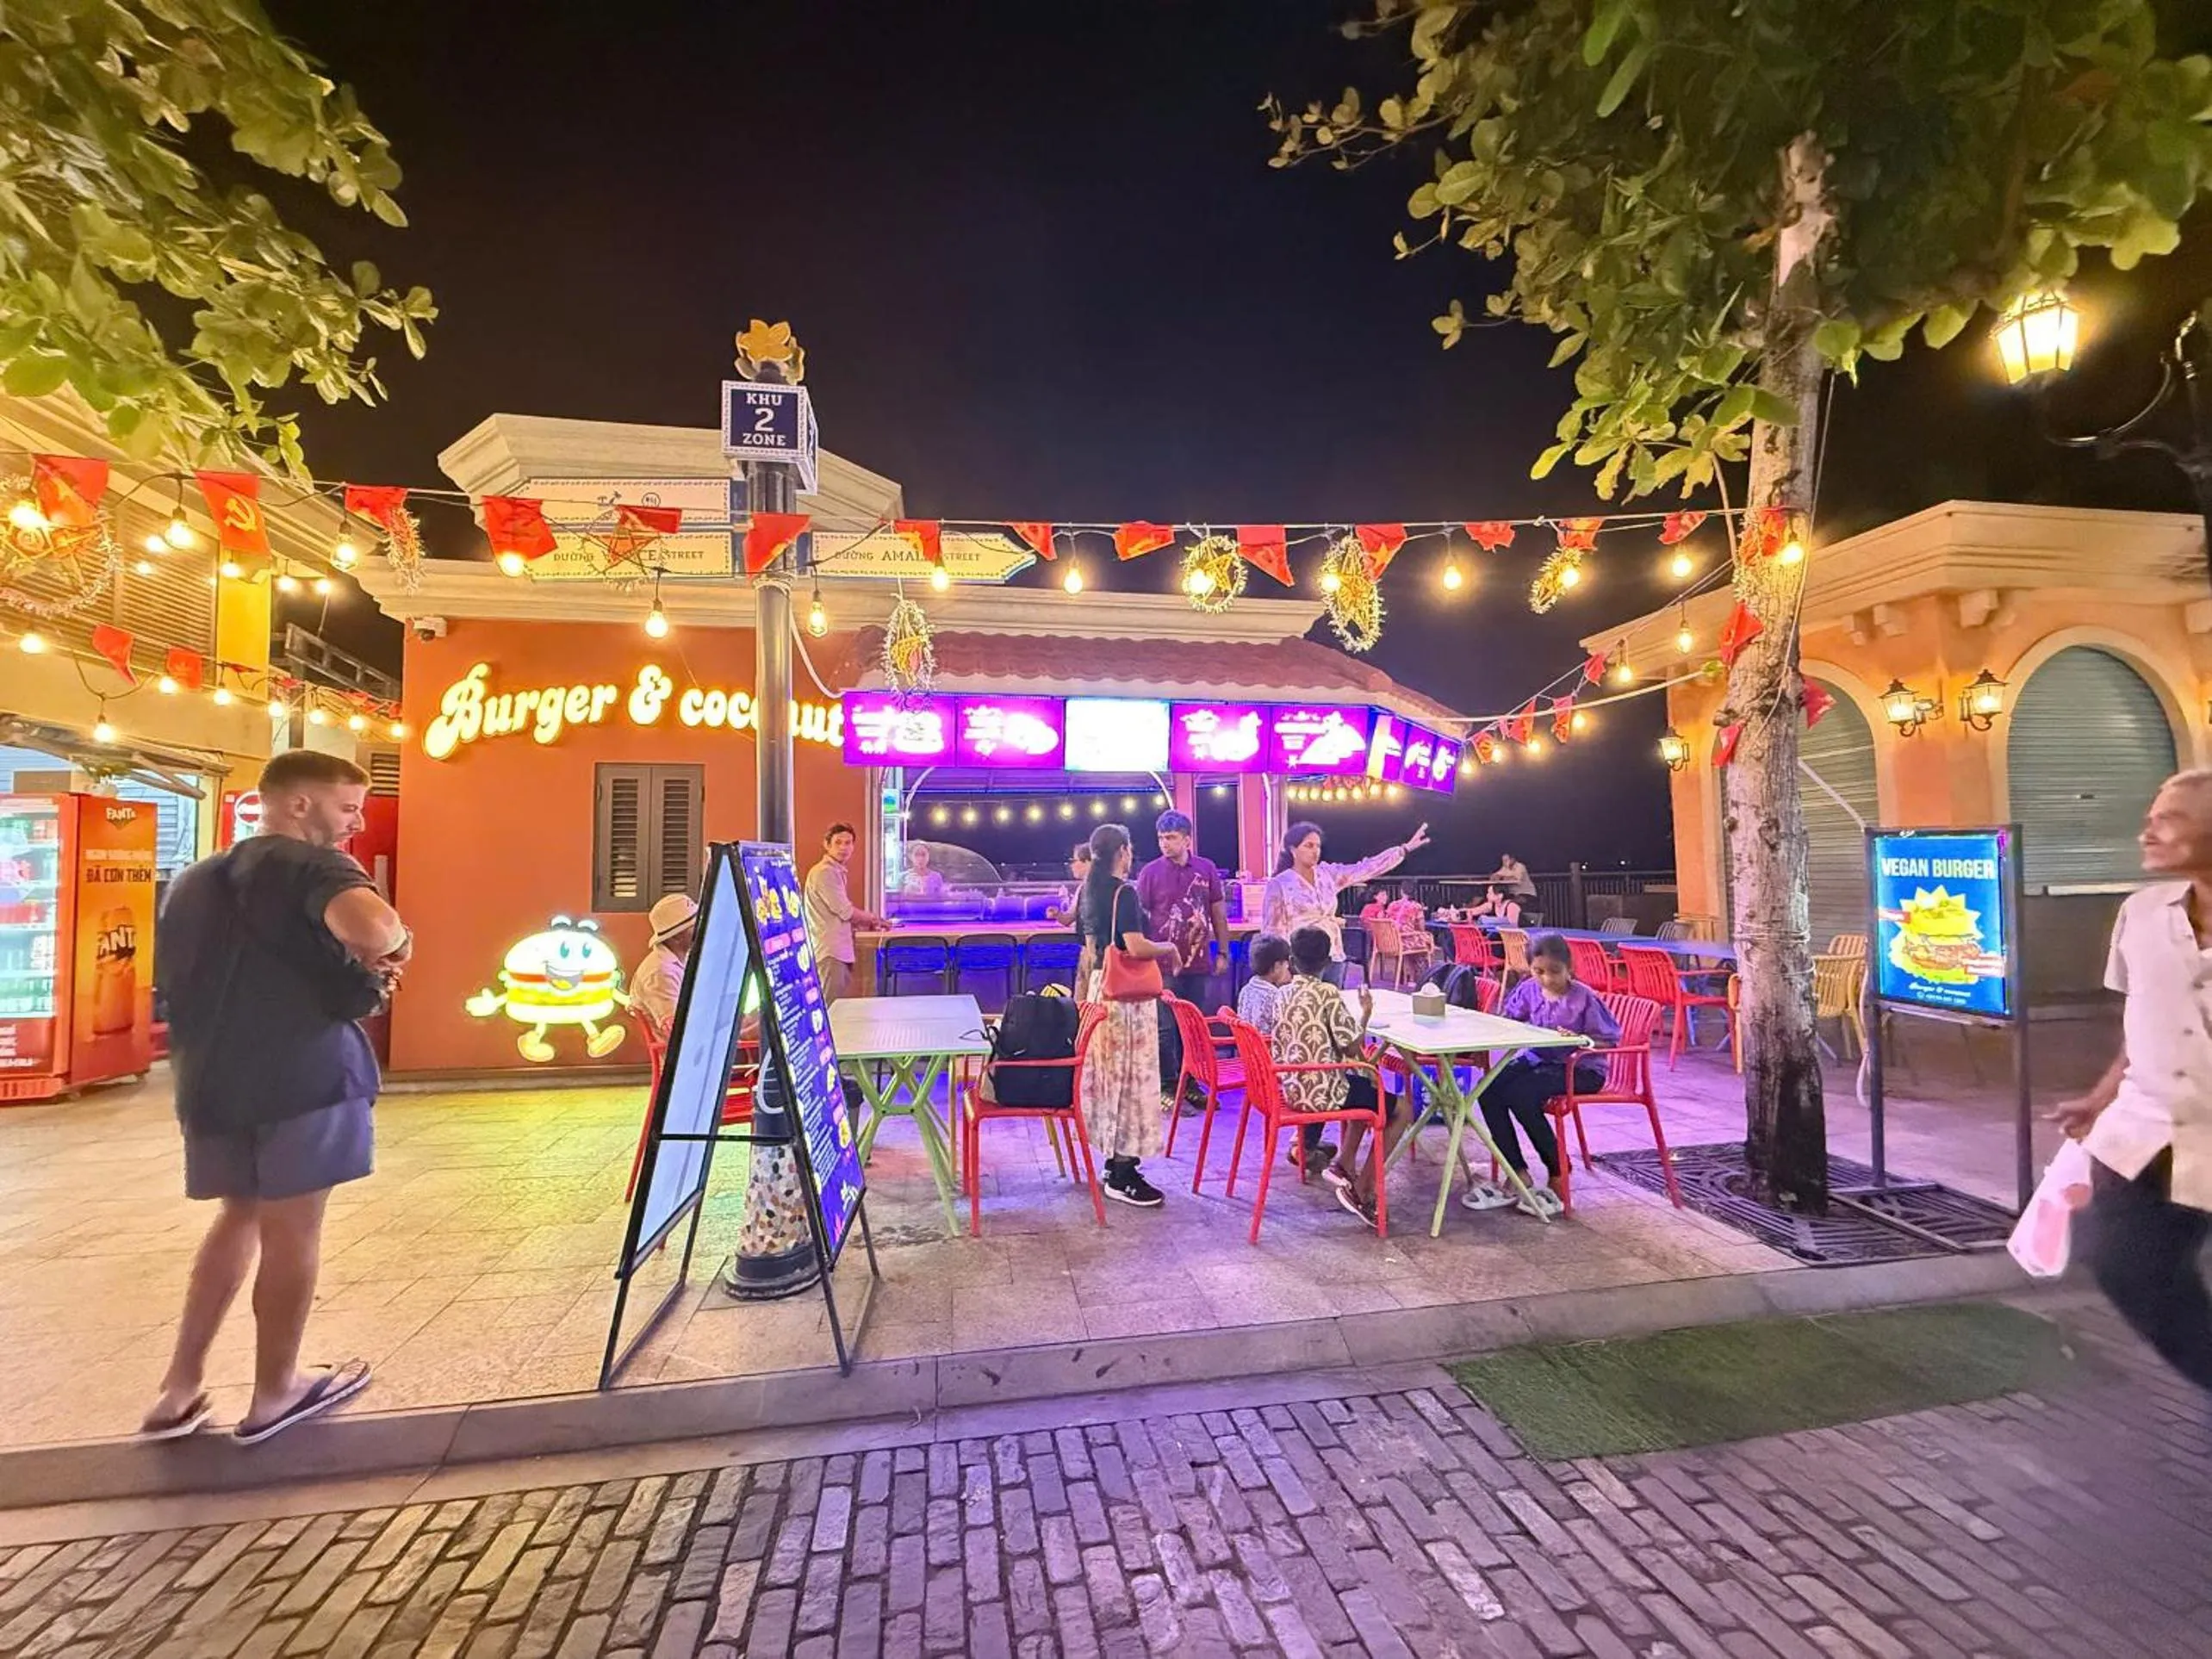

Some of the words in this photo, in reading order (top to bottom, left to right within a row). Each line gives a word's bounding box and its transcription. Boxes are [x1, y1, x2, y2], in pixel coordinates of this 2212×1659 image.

[745, 392, 783, 407] KHU
[754, 407, 774, 432] 2
[742, 432, 786, 446] ZONE
[880, 550, 930, 562] AMAL
[943, 551, 979, 562] STREET
[422, 662, 618, 761] Burger
[627, 663, 674, 726] &
[1880, 856, 1929, 878] VEGAN
[1931, 857, 1996, 880] BURGER
